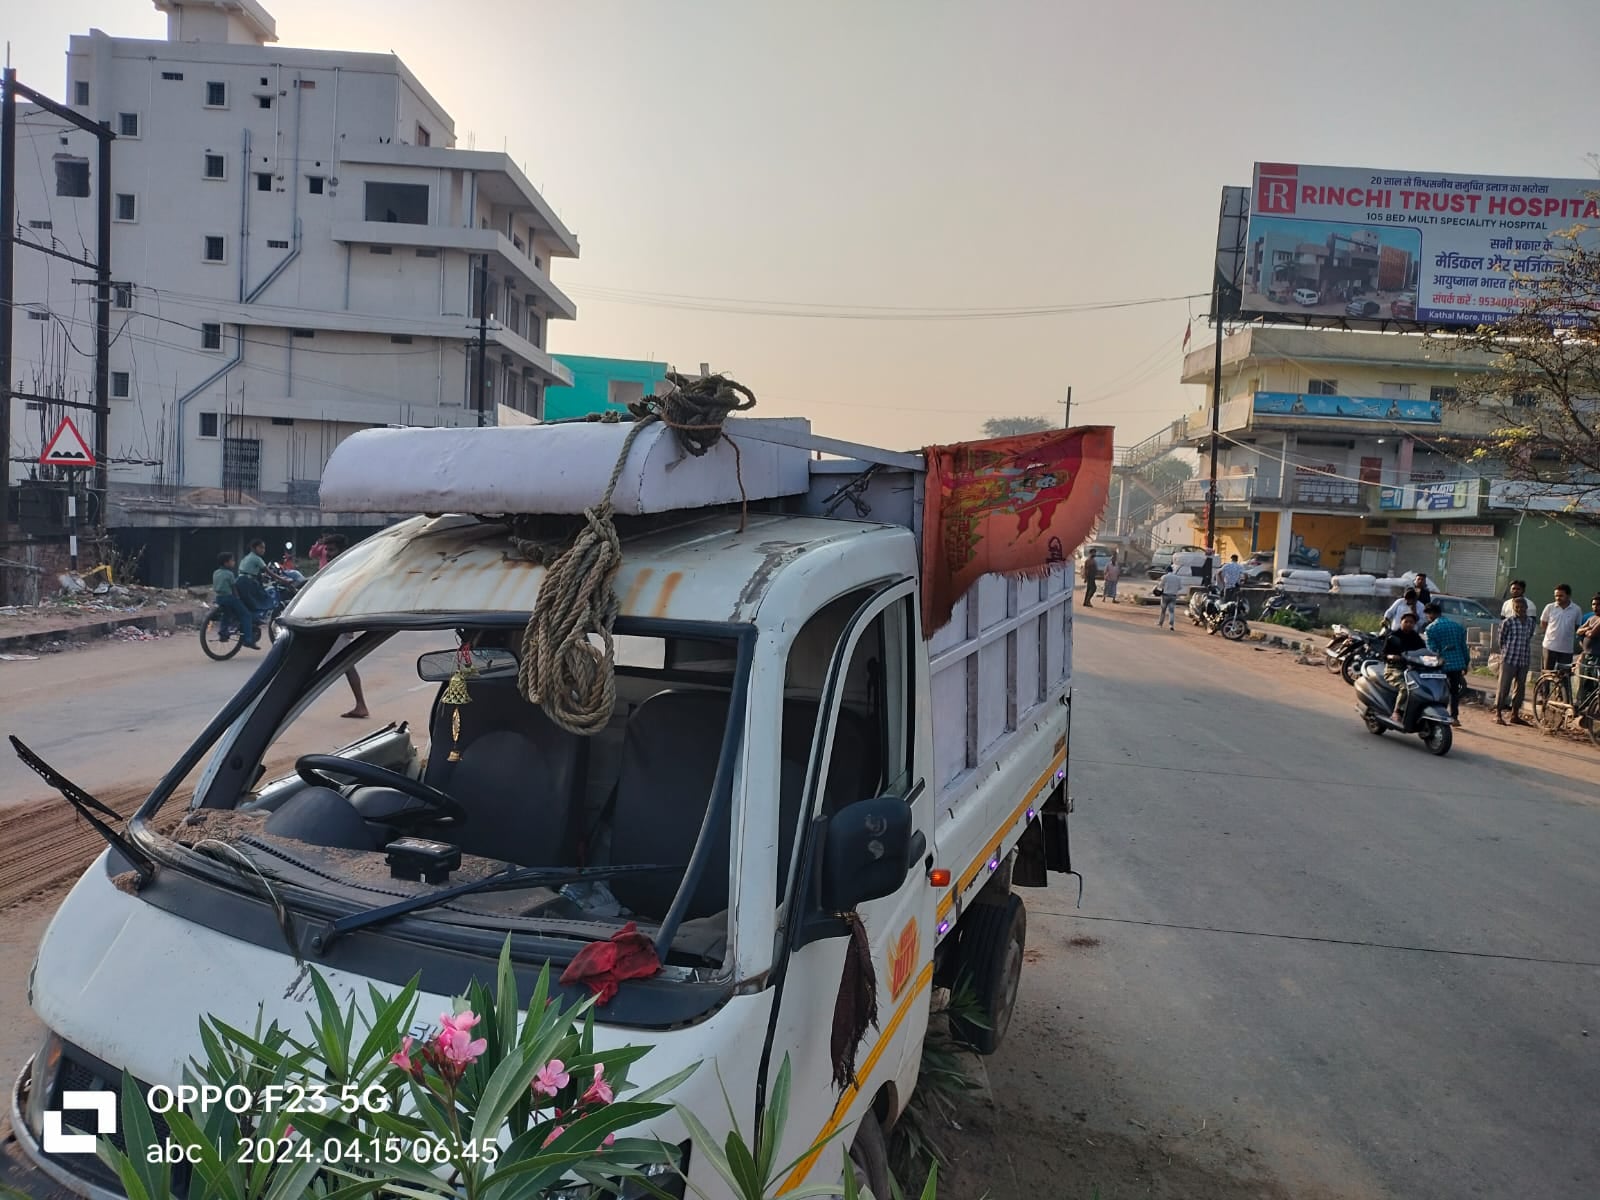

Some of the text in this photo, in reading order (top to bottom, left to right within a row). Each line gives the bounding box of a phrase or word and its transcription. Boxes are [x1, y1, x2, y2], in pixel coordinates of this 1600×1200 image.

[1371, 176, 1382, 185] 20
[1383, 177, 1402, 187] साल
[1403, 176, 1411, 187] से
[1510, 184, 1520, 193] का
[1522, 182, 1549, 194] भरोसा
[1301, 185, 1391, 209] RINCHI
[1399, 190, 1481, 214] TRUST
[1367, 212, 1548, 230] 105 BED MULTI SPECIALITY HOSPITAL
[1489, 237, 1553, 251] सभी प्रकार के
[1435, 251, 1483, 271] मेडिकल
[1480, 277, 1507, 289] भारत
[1429, 311, 1455, 320] Kathal
